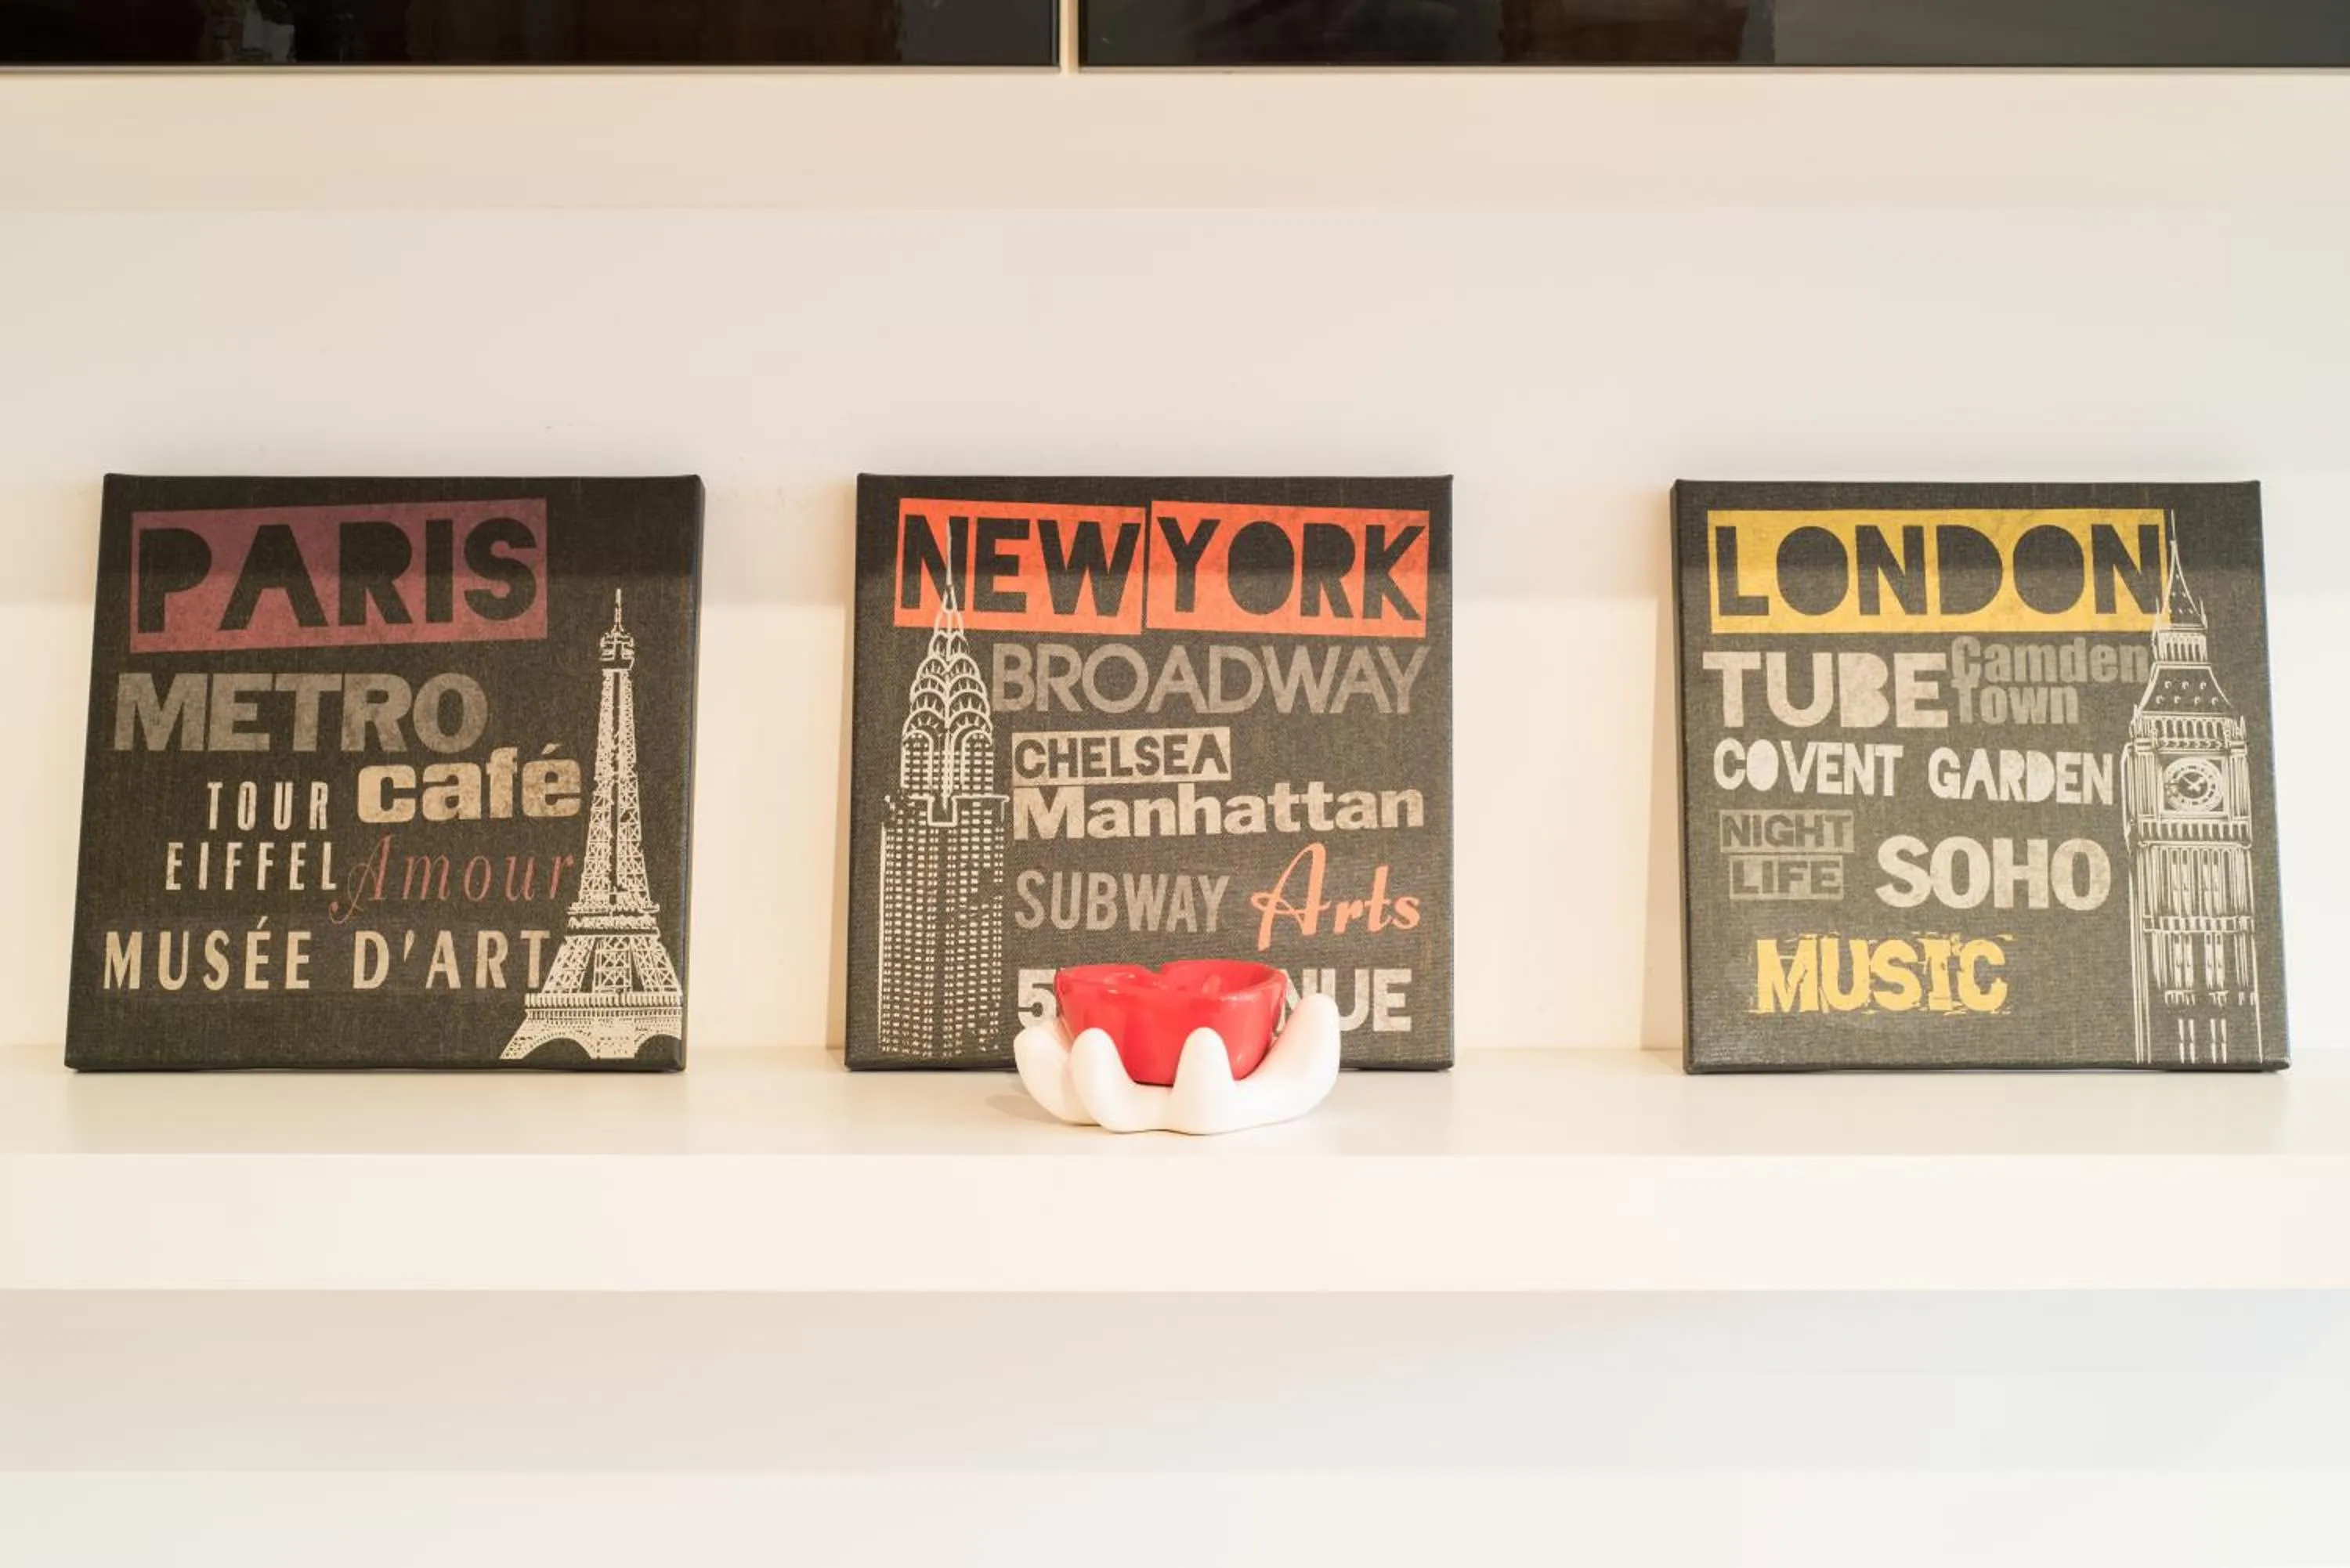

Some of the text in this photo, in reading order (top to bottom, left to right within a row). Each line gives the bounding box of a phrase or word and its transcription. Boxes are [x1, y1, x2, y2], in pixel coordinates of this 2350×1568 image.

[138, 518, 537, 633] PARIS
[901, 515, 1426, 621] NEW YORK
[1715, 523, 2162, 616] LONDON
[992, 642, 1431, 714] BROADWAY
[1703, 651, 1948, 728] TUBE
[1951, 636, 2153, 685] Camden
[114, 673, 488, 753] METRO
[1951, 677, 2080, 724] Town
[357, 743, 582, 823] café
[1014, 735, 1228, 779] CHELSEA
[1713, 739, 2113, 805] COVENT GARDEN
[208, 781, 327, 830] TOUR
[1014, 782, 1423, 840] Manhattan
[1723, 814, 1851, 847] NIGHT
[166, 841, 336, 891] EIFFEL
[329, 833, 575, 923] Amour
[1014, 871, 1230, 933] SUBWAY
[1252, 842, 1420, 951] Arts
[1733, 860, 1842, 894] LIFE
[1875, 835, 2111, 910] SOHO
[103, 916, 550, 990] MUSÉE D'ART
[1755, 934, 2010, 1013] MUSIC
